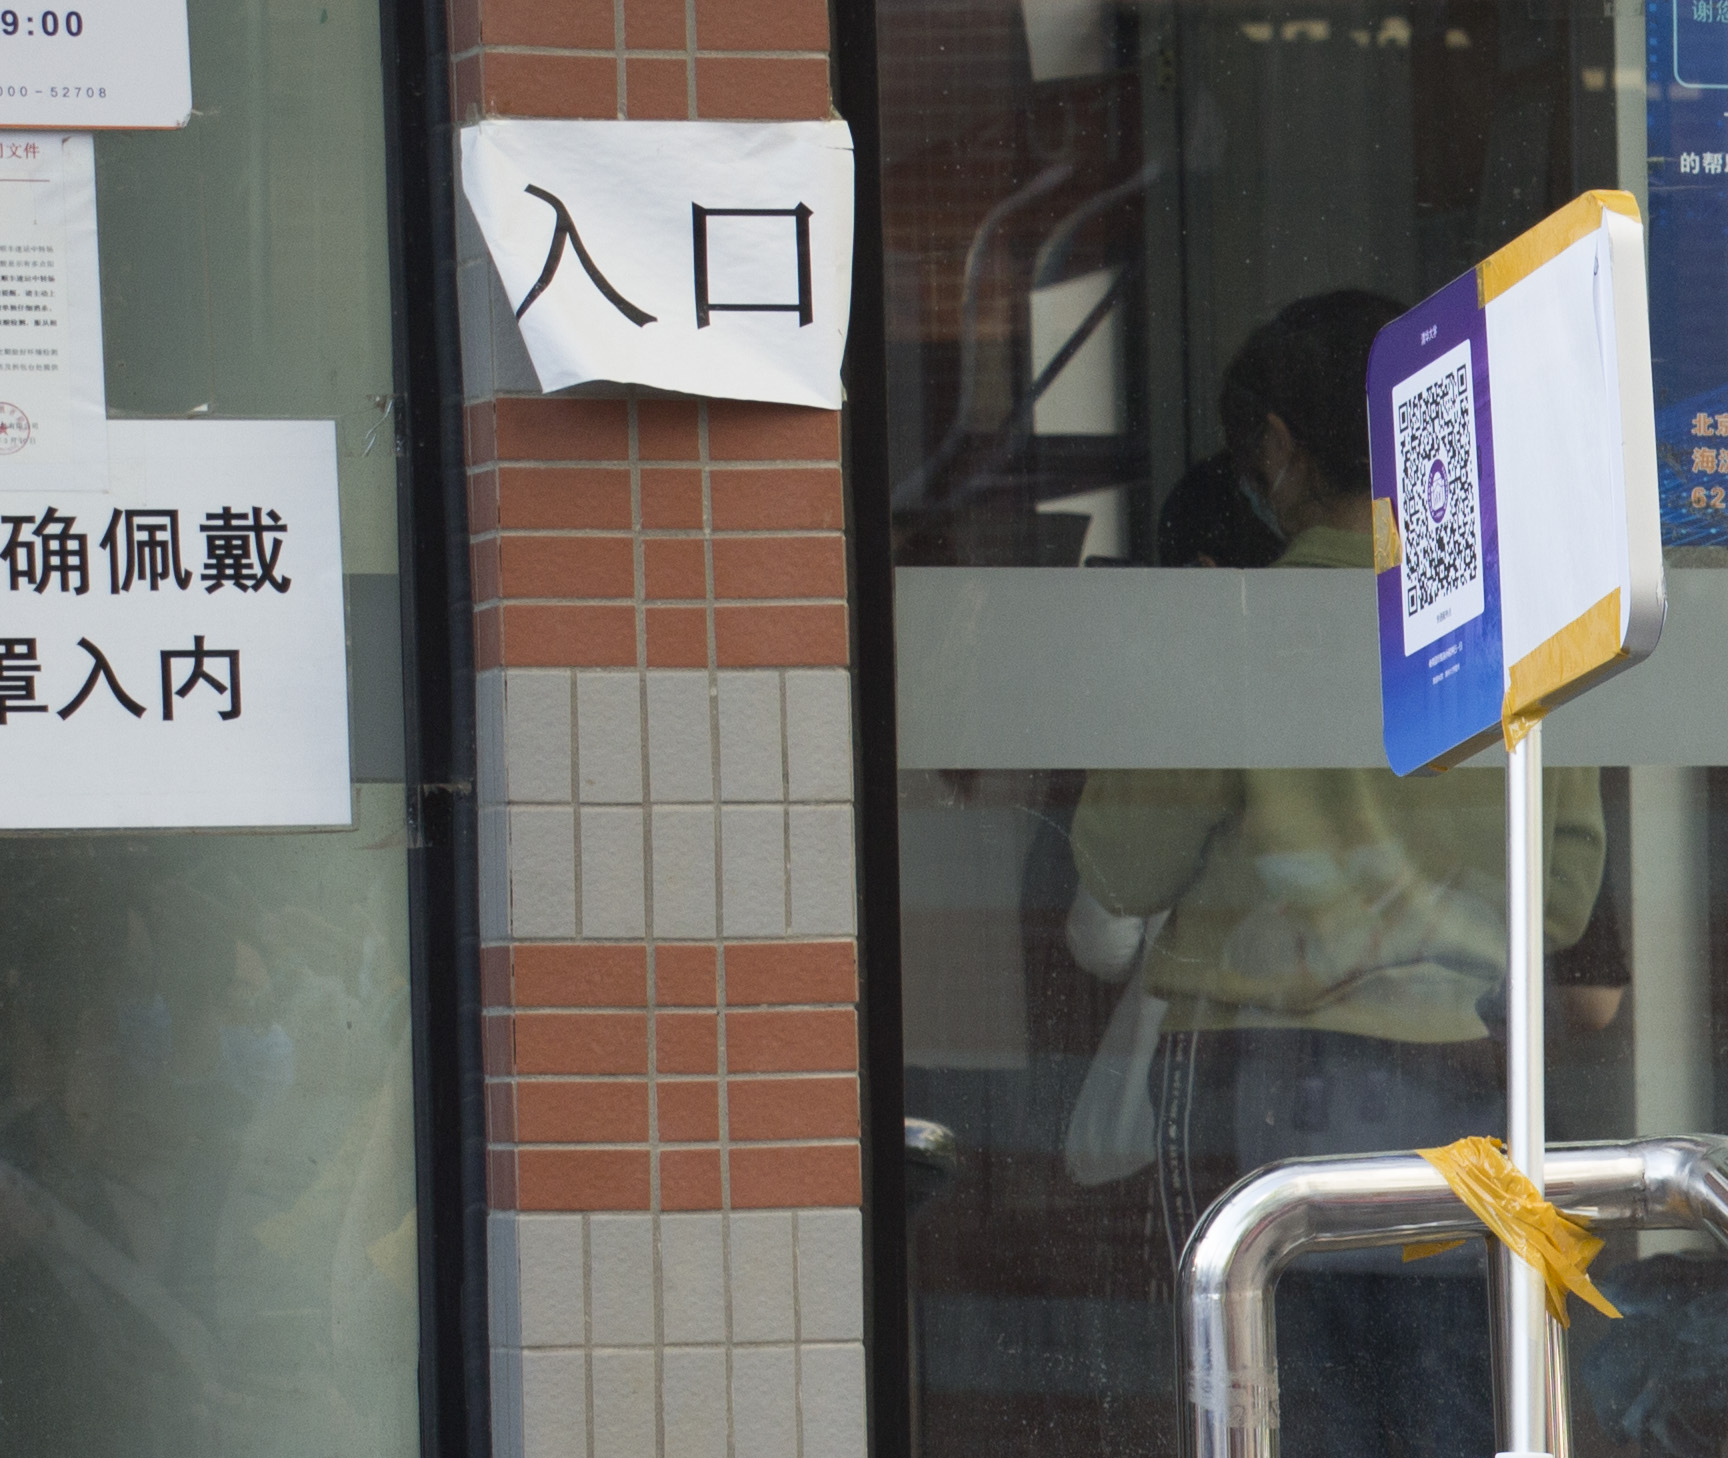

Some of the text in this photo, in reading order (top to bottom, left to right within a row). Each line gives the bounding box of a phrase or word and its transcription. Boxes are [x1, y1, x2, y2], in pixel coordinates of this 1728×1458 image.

[515, 183, 814, 330] 入口
[0, 506, 292, 596] 确佩戴
